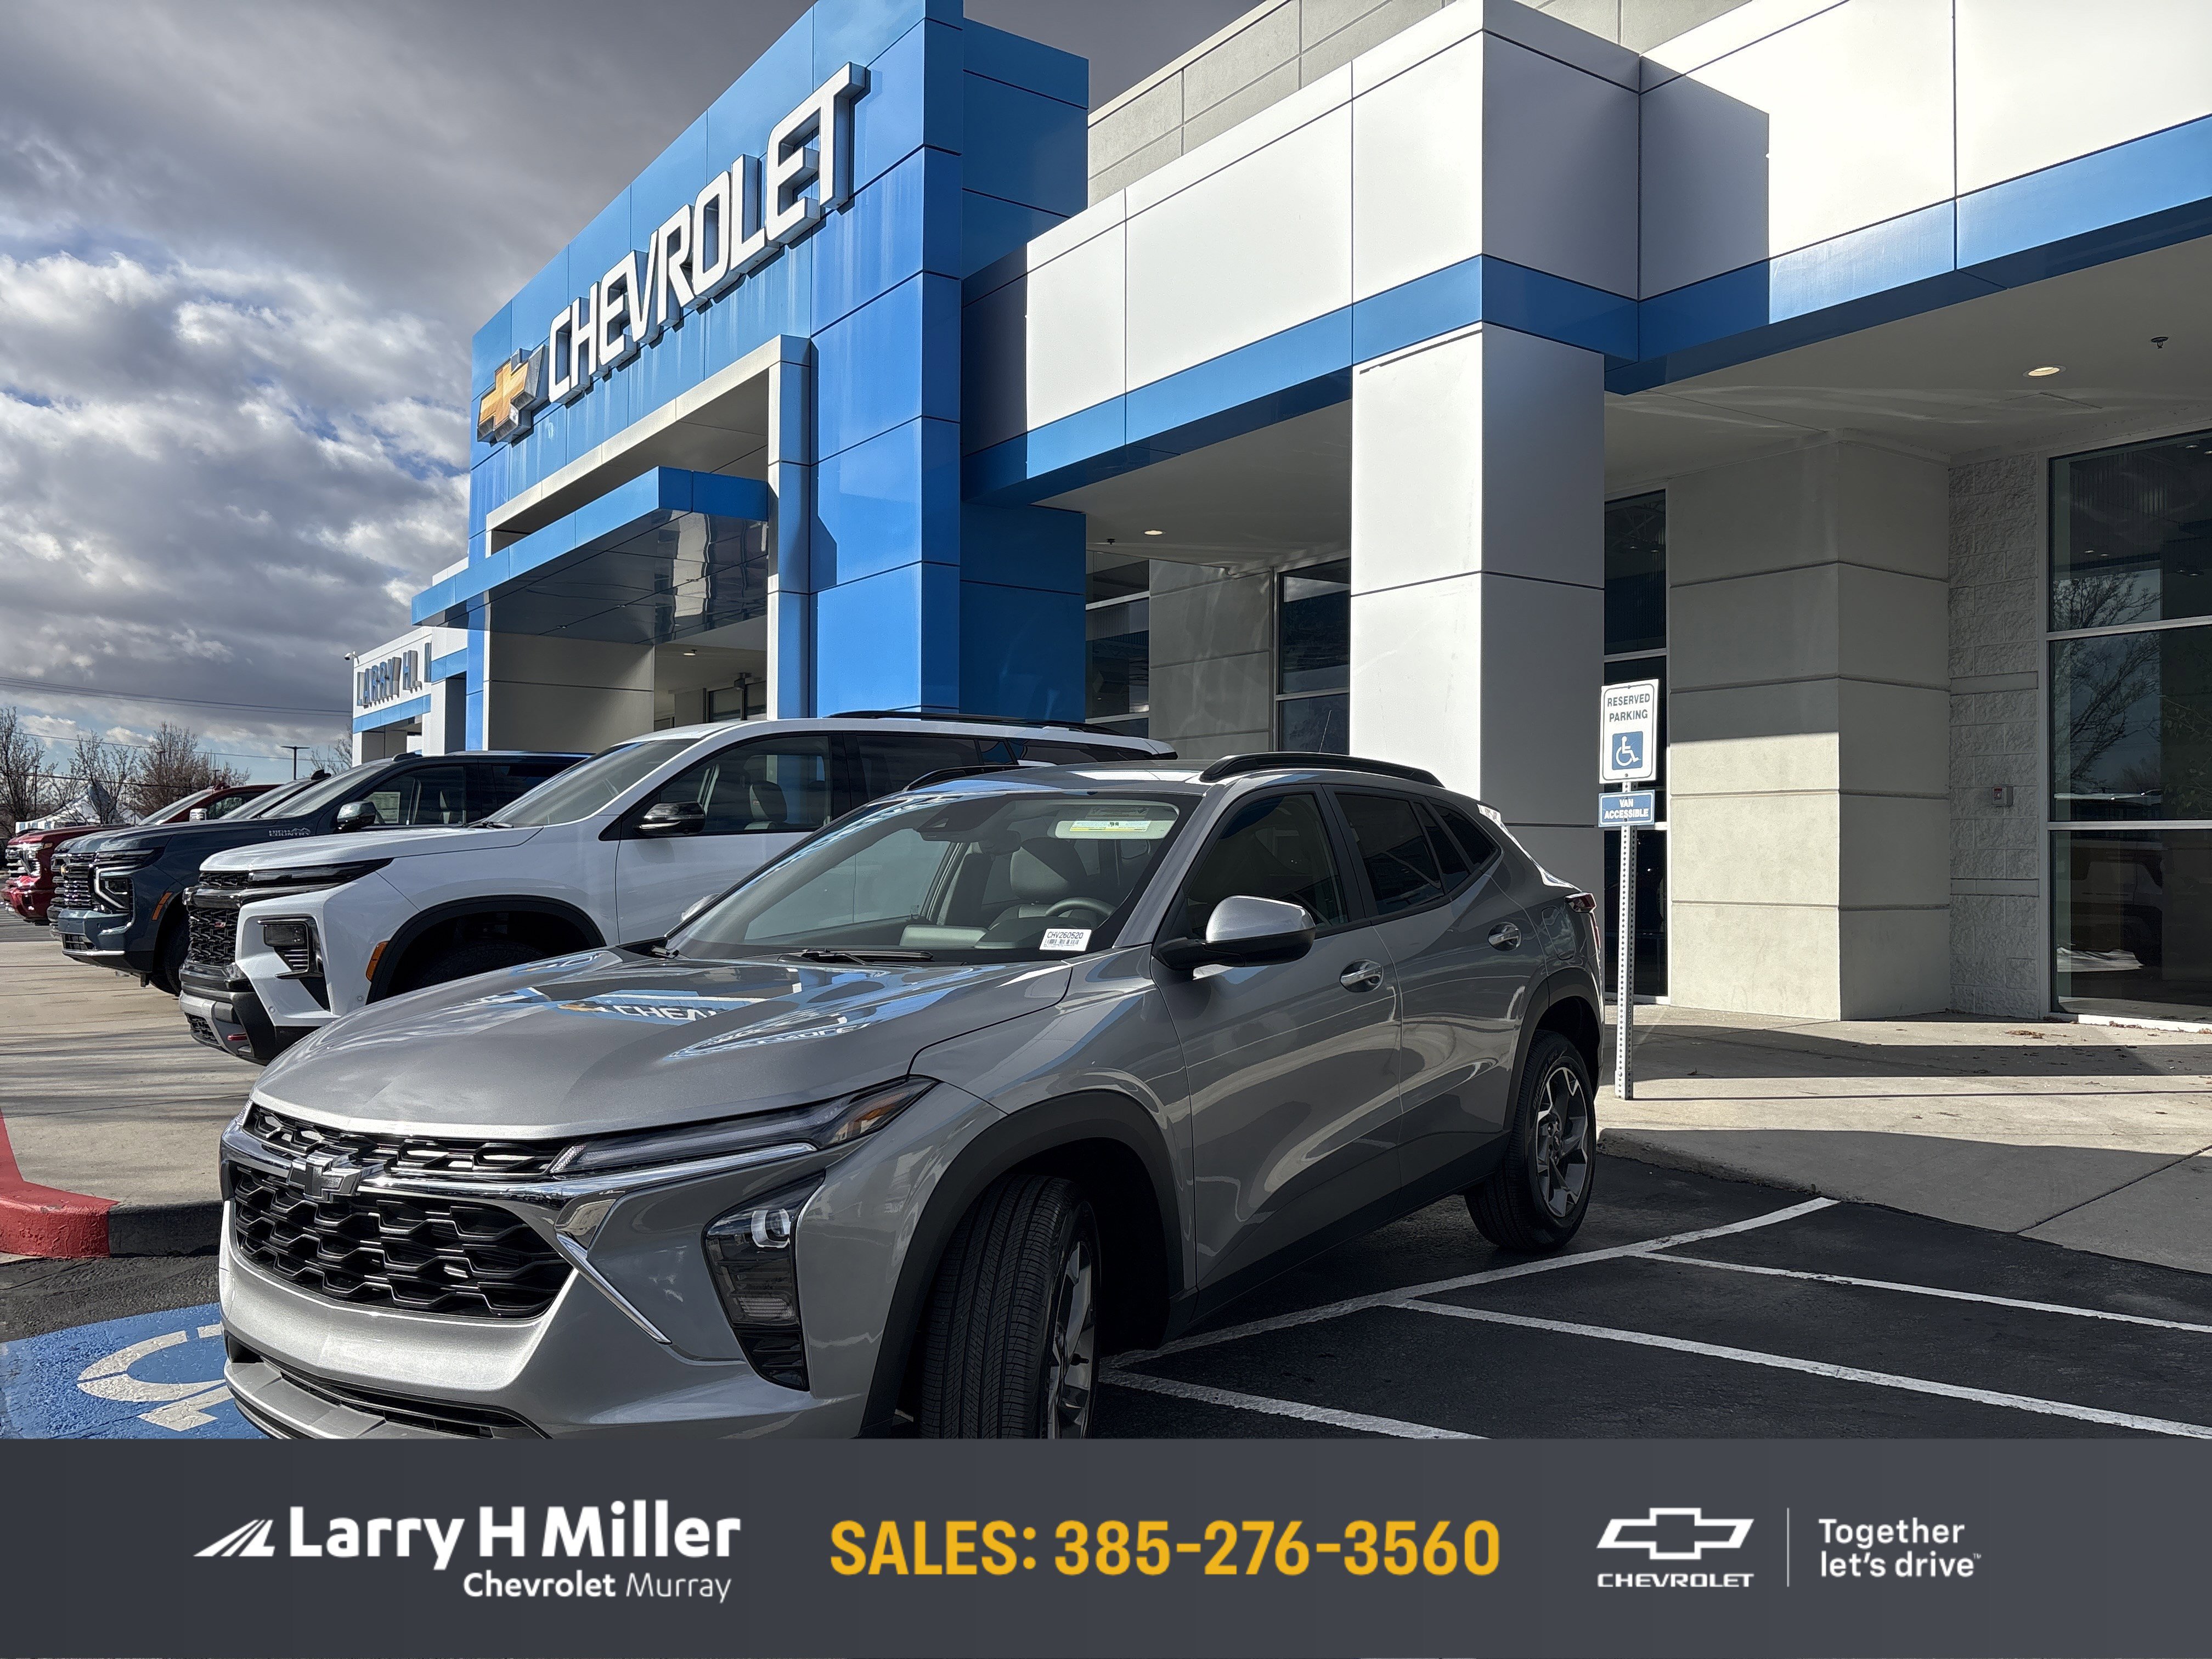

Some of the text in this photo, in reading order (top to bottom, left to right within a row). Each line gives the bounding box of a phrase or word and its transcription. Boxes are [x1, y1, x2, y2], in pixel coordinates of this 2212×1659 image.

[549, 61, 866, 404] CHEVROLET
[357, 657, 402, 707] LARRY
[1607, 693, 1650, 707] RESERVED
[1609, 709, 1648, 722] PARKING
[1619, 799, 1634, 808] VAN
[1604, 809, 1649, 820] ACCESSIBLE
